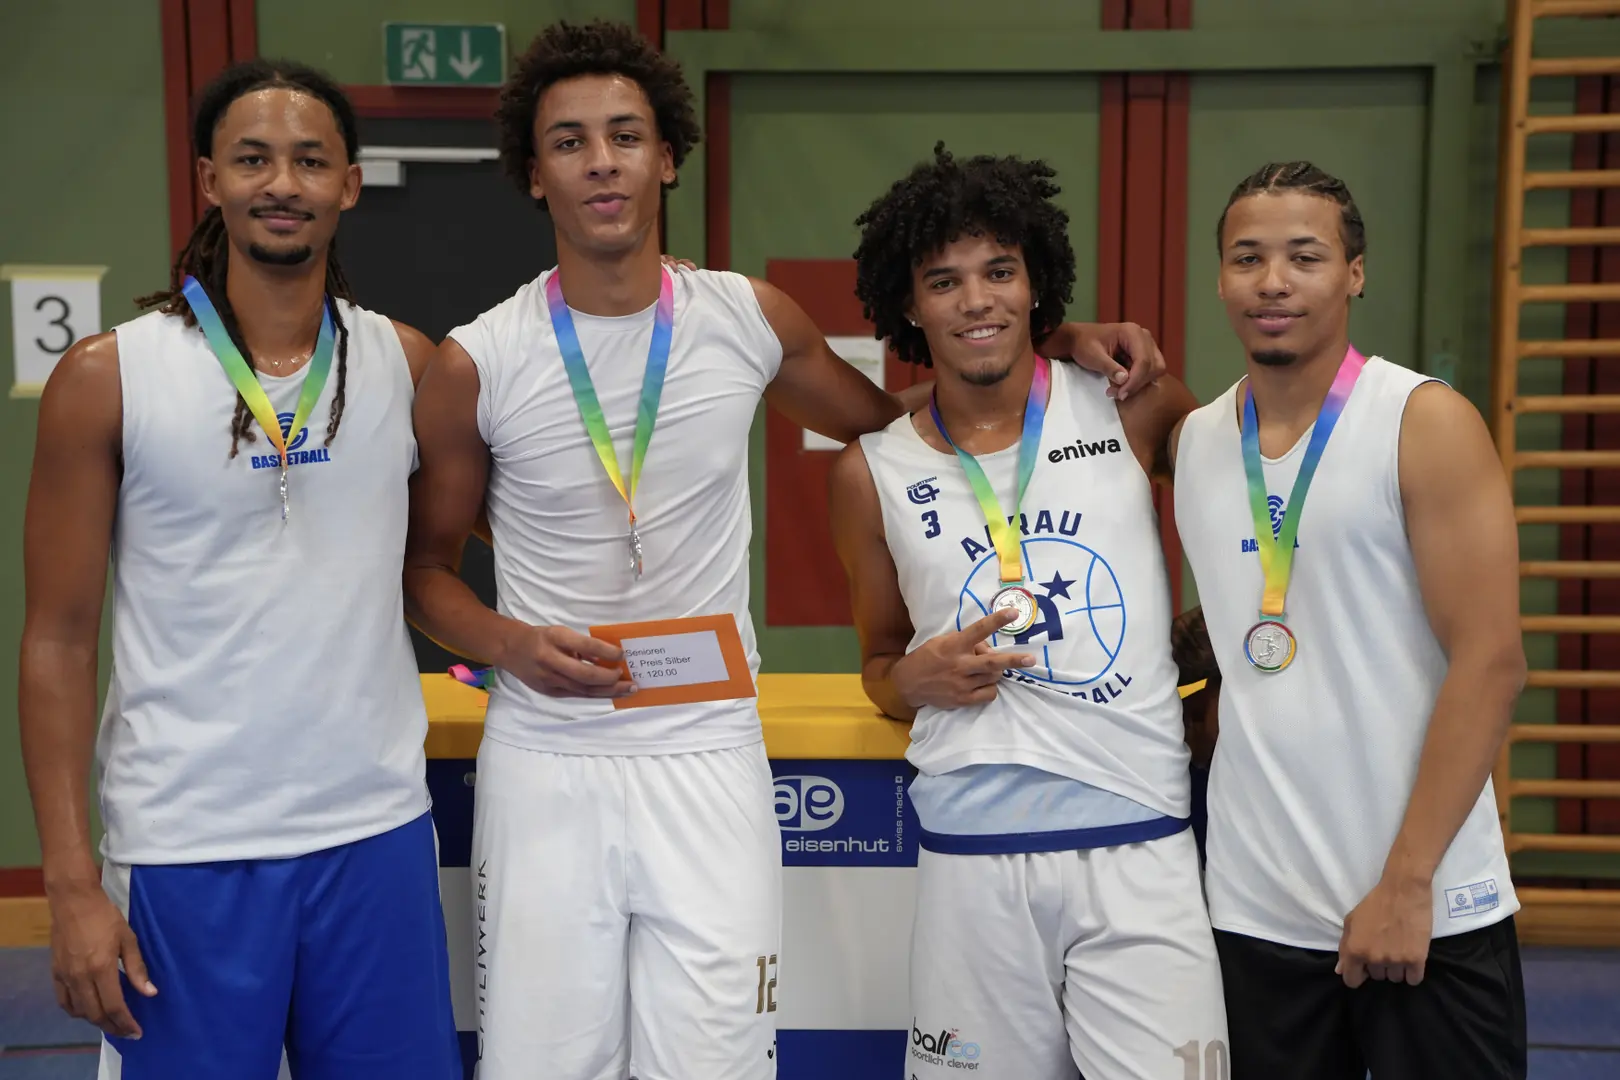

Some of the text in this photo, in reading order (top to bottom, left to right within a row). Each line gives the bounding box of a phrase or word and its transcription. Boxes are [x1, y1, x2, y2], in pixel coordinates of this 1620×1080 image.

[35, 296, 74, 354] 3
[1048, 438, 1121, 463] eniwa
[921, 510, 941, 539] 3
[625, 647, 666, 657] Senioren
[628, 656, 691, 669] 2. Preis Silber
[647, 668, 677, 678] 120.00
[895, 785, 903, 853] swiss made
[786, 836, 889, 853] eisenhut
[947, 1058, 980, 1070] clever
